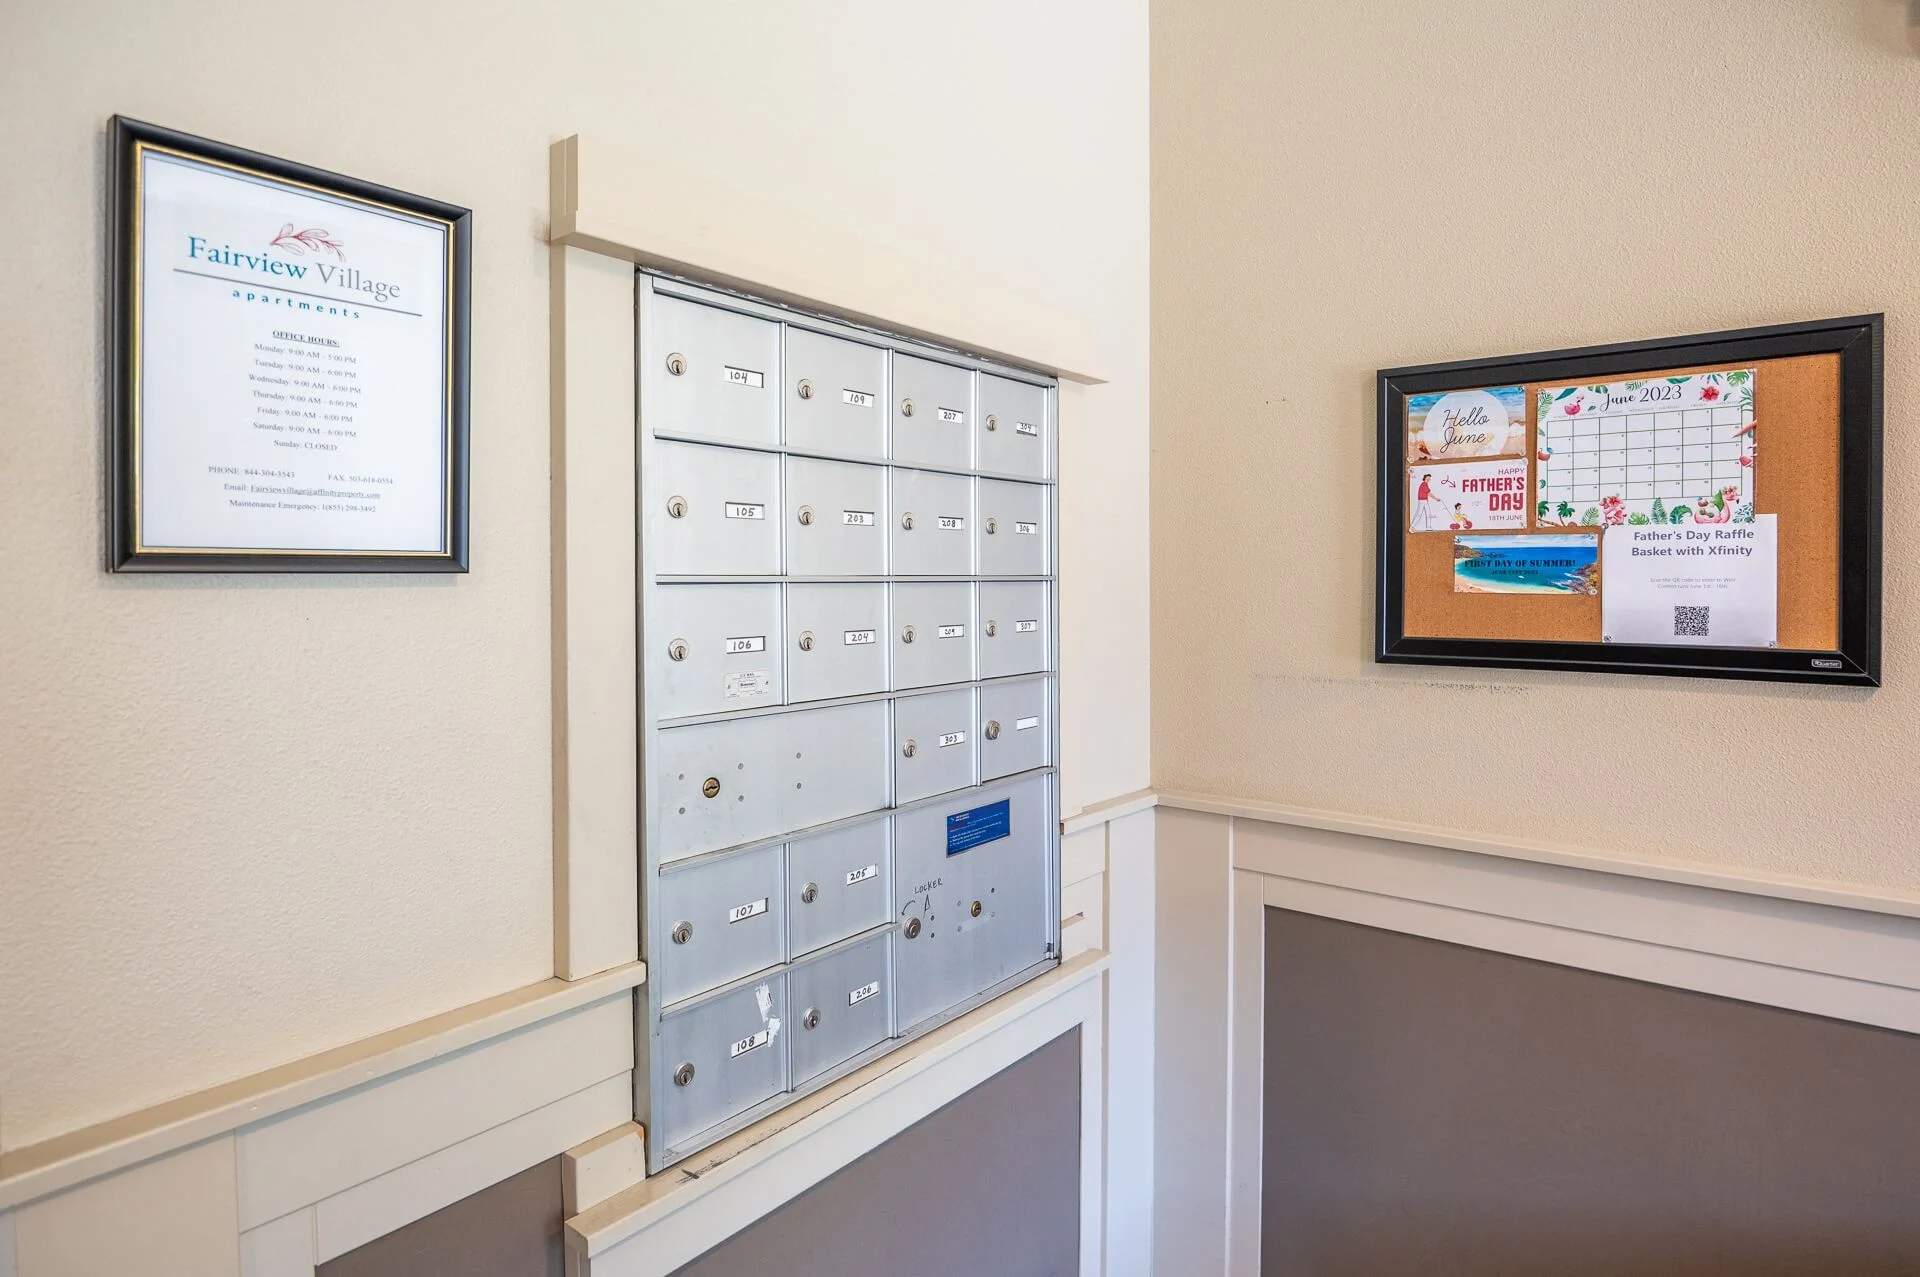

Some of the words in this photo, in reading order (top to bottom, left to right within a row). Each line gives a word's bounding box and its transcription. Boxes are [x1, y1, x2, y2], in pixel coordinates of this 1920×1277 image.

[188, 236, 308, 279] Fairview
[314, 262, 401, 302] Village
[232, 289, 360, 319] apartments
[272, 330, 306, 342] OFFICE
[307, 336, 340, 348] HOURS:
[288, 348, 305, 357] 9:00
[306, 351, 320, 359] AM
[288, 364, 305, 372] 9:00
[344, 371, 357, 379] PM
[730, 371, 748, 384] 104
[294, 379, 310, 387] 9:00
[311, 382, 325, 390] AM
[850, 393, 865, 405] 109
[1599, 391, 1637, 412] June
[1639, 384, 1682, 402] 2023
[345, 401, 358, 409] PM
[285, 409, 301, 417] 9:00
[341, 415, 353, 423] PM
[943, 411, 957, 420] 207
[1442, 406, 1490, 428] Hello
[288, 425, 305, 433] 9:00
[307, 427, 320, 435] AM
[274, 439, 302, 449] Sunday:
[304, 442, 338, 451] CLOSED
[1440, 426, 1486, 453] June
[224, 483, 248, 491] Email:
[1462, 476, 1525, 493] FATHER'S
[229, 499, 277, 508] Maintenance
[278, 502, 319, 511] Emergency:
[1489, 492, 1524, 511] DAY
[736, 507, 755, 517] 105
[847, 514, 865, 524] 203
[941, 519, 956, 528] 208
[1634, 531, 1682, 541] Father's
[1686, 530, 1711, 542] Day
[1715, 529, 1755, 540] Raffle
[1632, 547, 1672, 557] Basket
[1676, 546, 1704, 556] with
[1708, 545, 1753, 557] Xfinity
[1464, 559, 1491, 568] FIRST
[1494, 559, 1512, 568] DAY
[1515, 559, 1527, 568] OF
[1529, 559, 1576, 567] SUMMER!
[851, 632, 870, 642] 204
[733, 640, 752, 651] 106
[945, 735, 957, 744] 303
[850, 866, 868, 881] 205
[914, 878, 943, 894] LOCKER
[736, 904, 754, 918] 107
[856, 985, 872, 999] 206
[737, 1035, 755, 1052] 108
